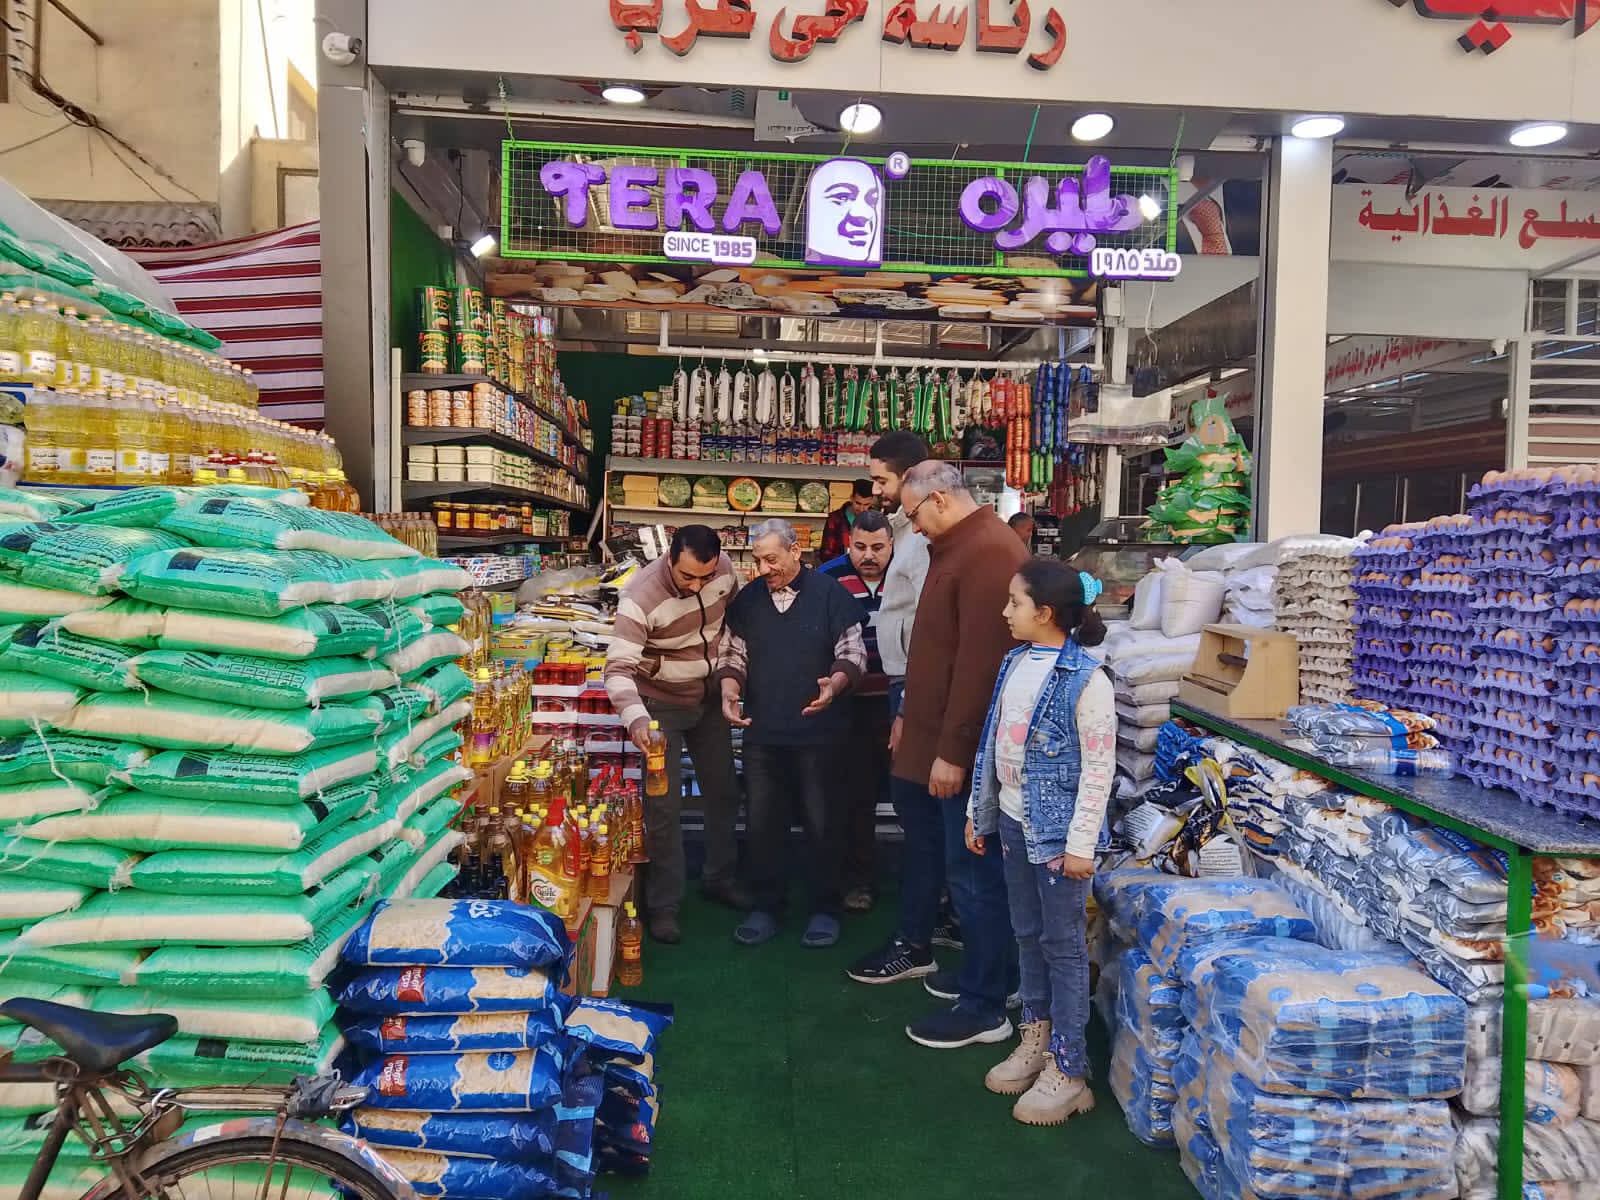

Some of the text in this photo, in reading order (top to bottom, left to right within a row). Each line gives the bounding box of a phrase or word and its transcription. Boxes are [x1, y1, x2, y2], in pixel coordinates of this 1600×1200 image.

[540, 160, 783, 236] TERA
[667, 236, 753, 258] SINCE 1985
[1095, 252, 1179, 272] منذ ١٩٨٥
